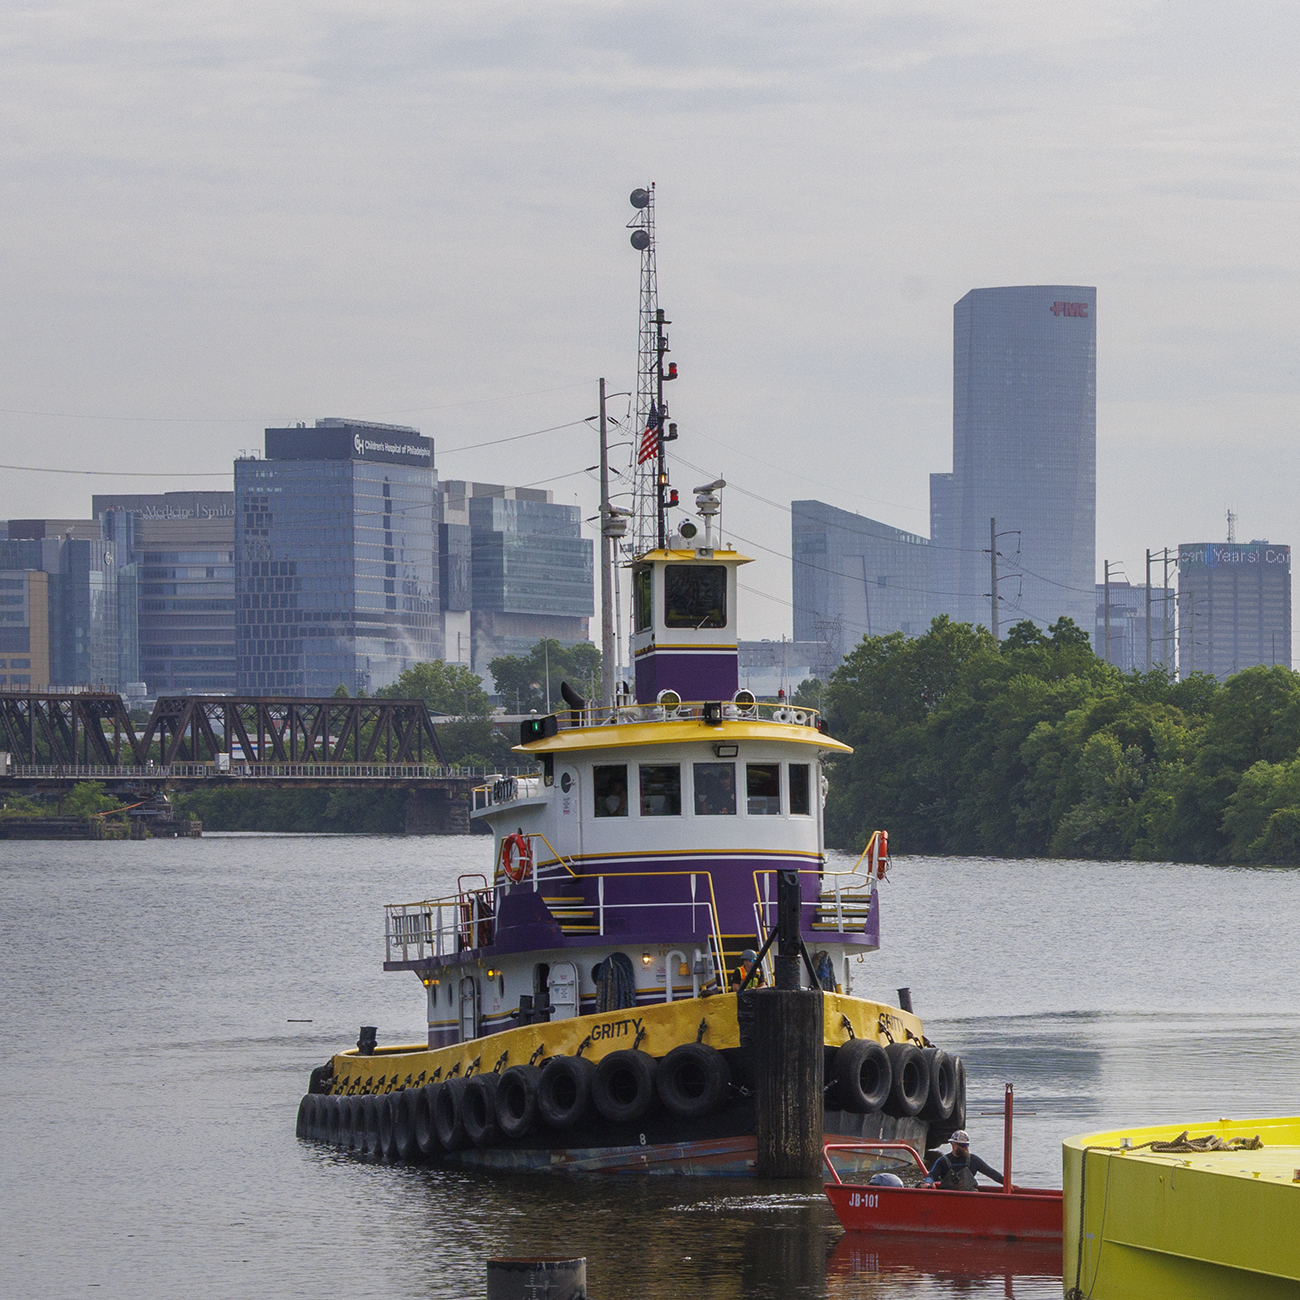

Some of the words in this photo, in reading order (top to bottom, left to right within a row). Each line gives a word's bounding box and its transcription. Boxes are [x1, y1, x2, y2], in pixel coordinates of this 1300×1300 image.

[1050, 301, 1088, 318] FMC
[1213, 548, 1260, 563] Years!
[591, 1017, 643, 1041] GRITTY
[849, 1193, 879, 1208] JB-101
